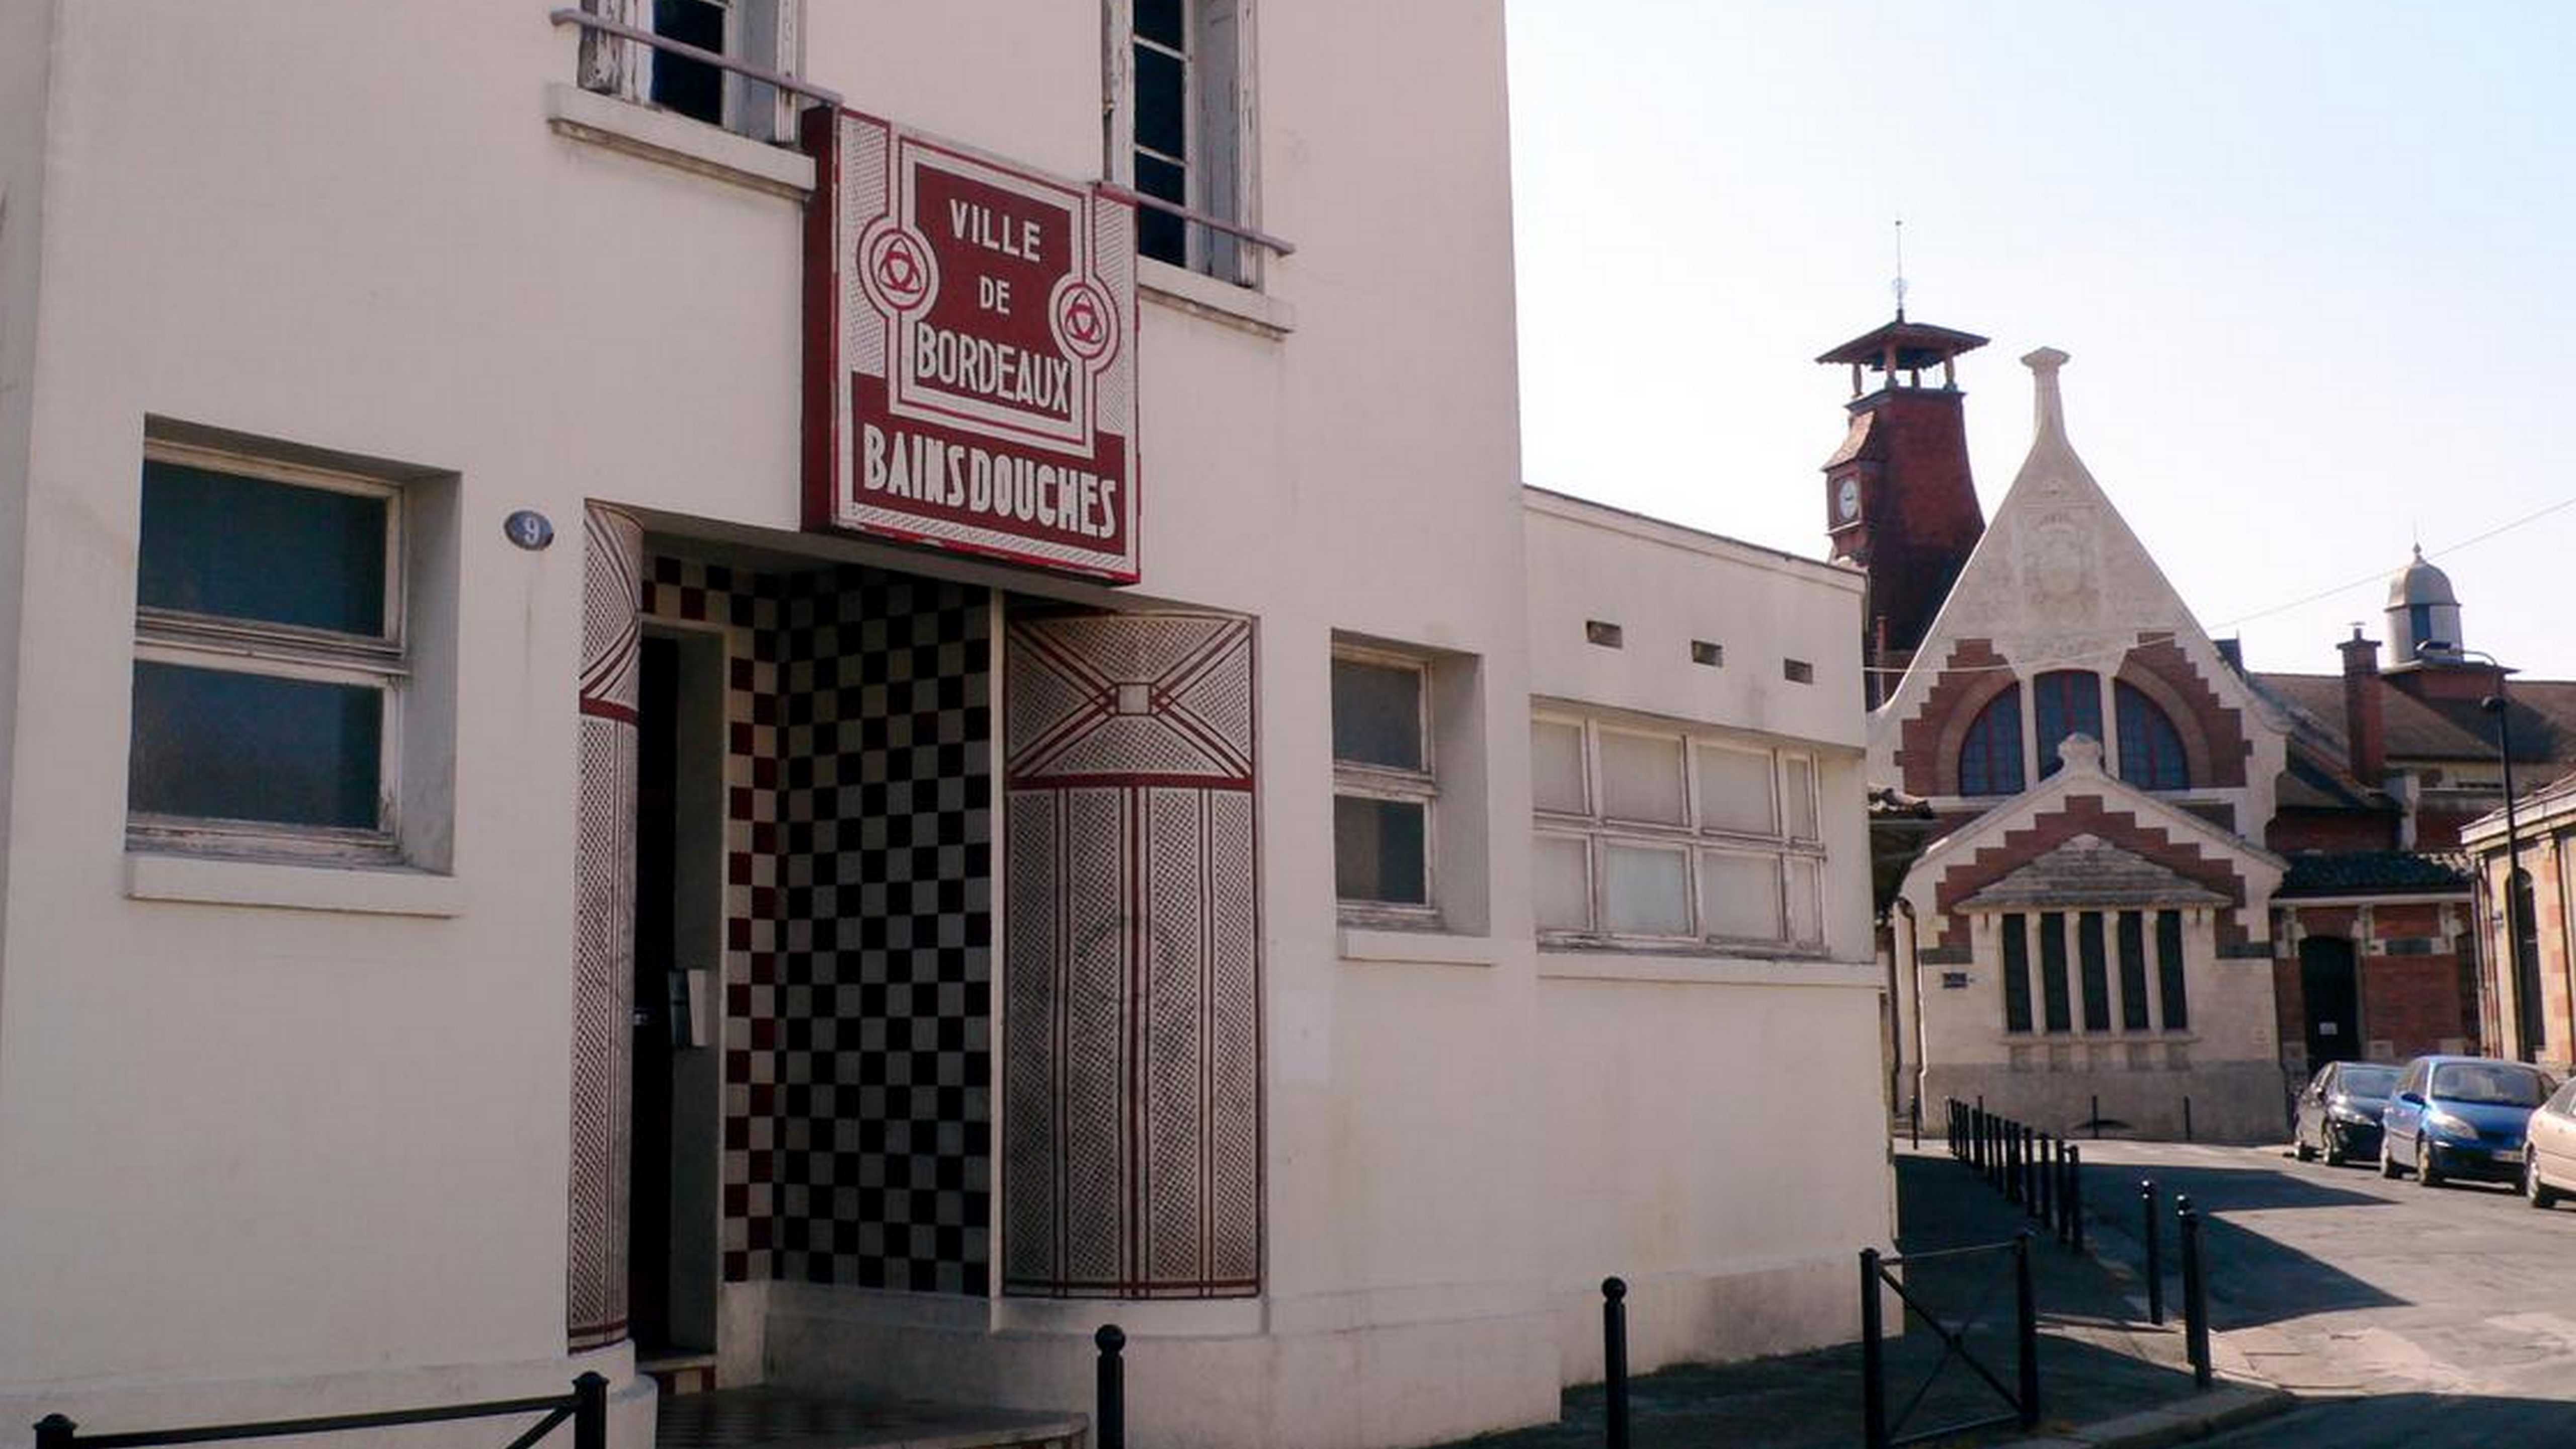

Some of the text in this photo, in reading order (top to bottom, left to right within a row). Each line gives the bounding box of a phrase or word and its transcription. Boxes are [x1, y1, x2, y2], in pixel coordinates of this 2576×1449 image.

[949, 199, 1040, 262] VILLE
[979, 275, 1010, 314] DE
[916, 321, 1070, 414] BORDEAUX
[863, 423, 1116, 538] BAINS DOUCHES
[524, 516, 540, 545] 9
